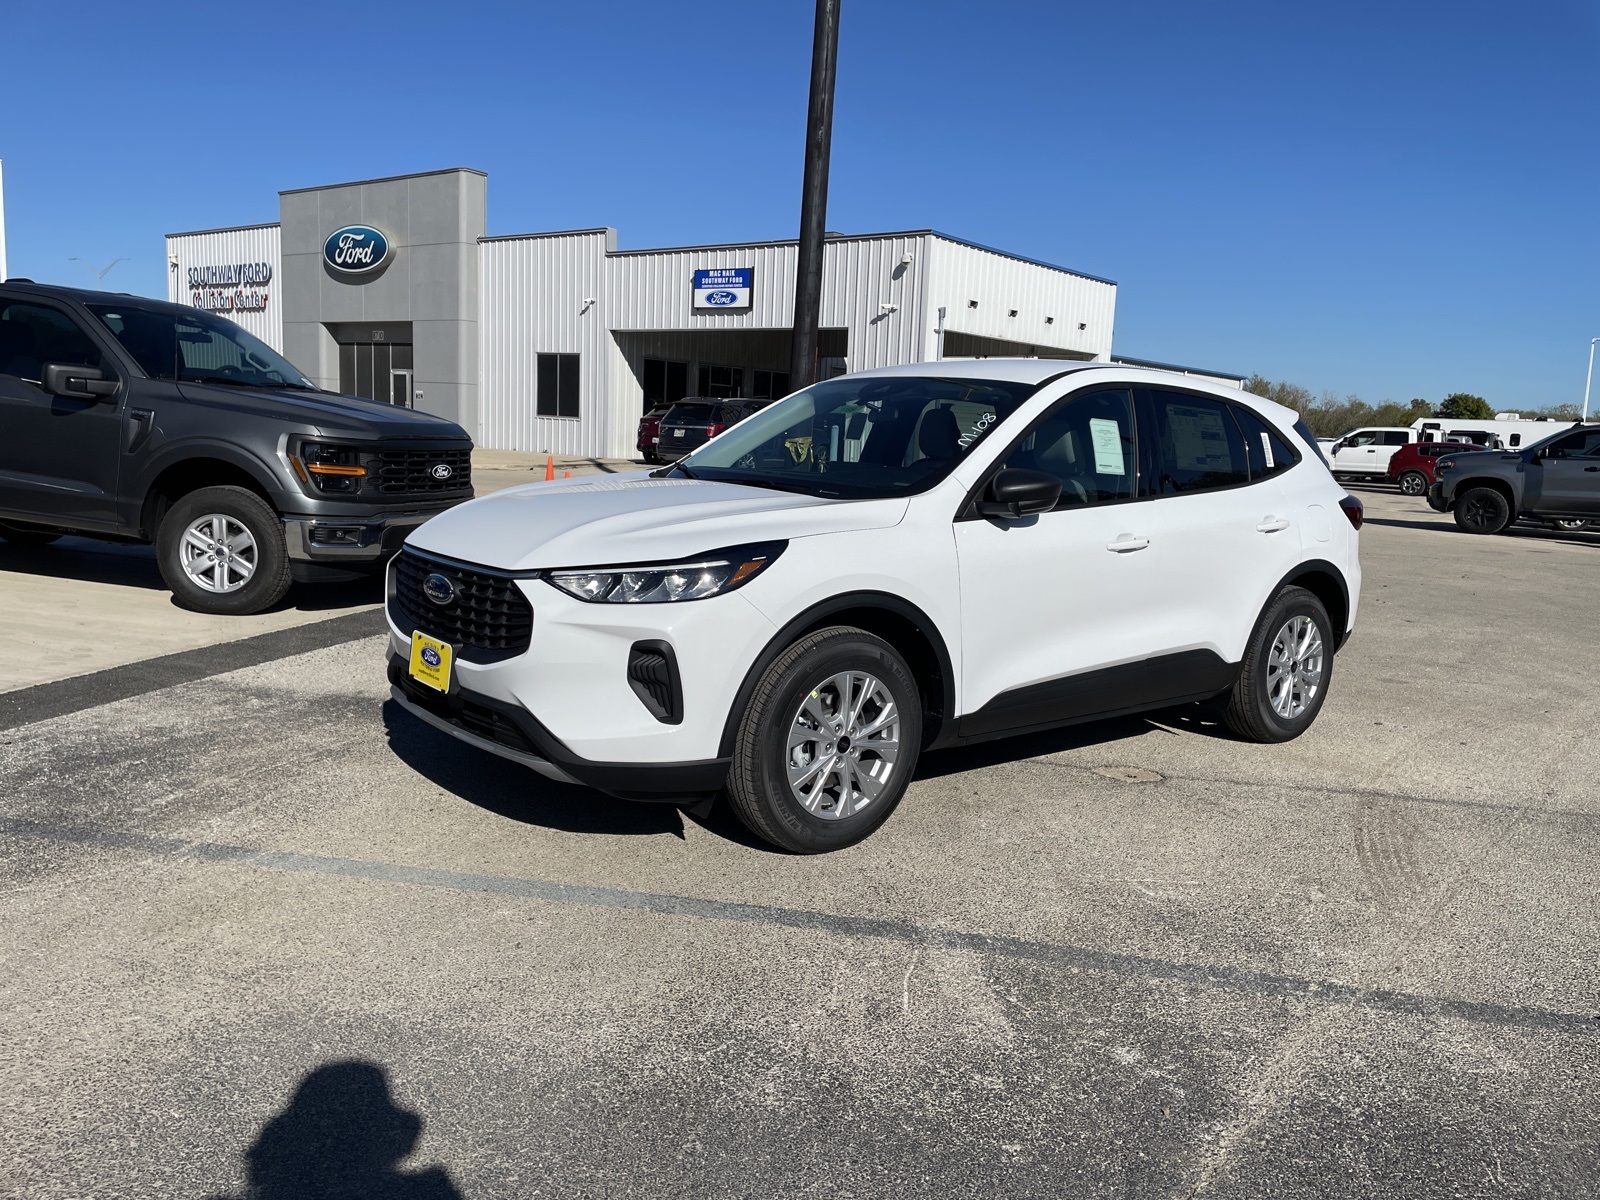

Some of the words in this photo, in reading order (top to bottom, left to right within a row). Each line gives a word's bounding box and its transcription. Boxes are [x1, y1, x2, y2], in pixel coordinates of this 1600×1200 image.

[335, 233, 375, 264] Ford
[188, 264, 240, 285] SOUTHWAY
[242, 261, 269, 283] FORD
[192, 289, 231, 310] Collision
[233, 289, 266, 308] Center
[711, 292, 732, 304] Ford
